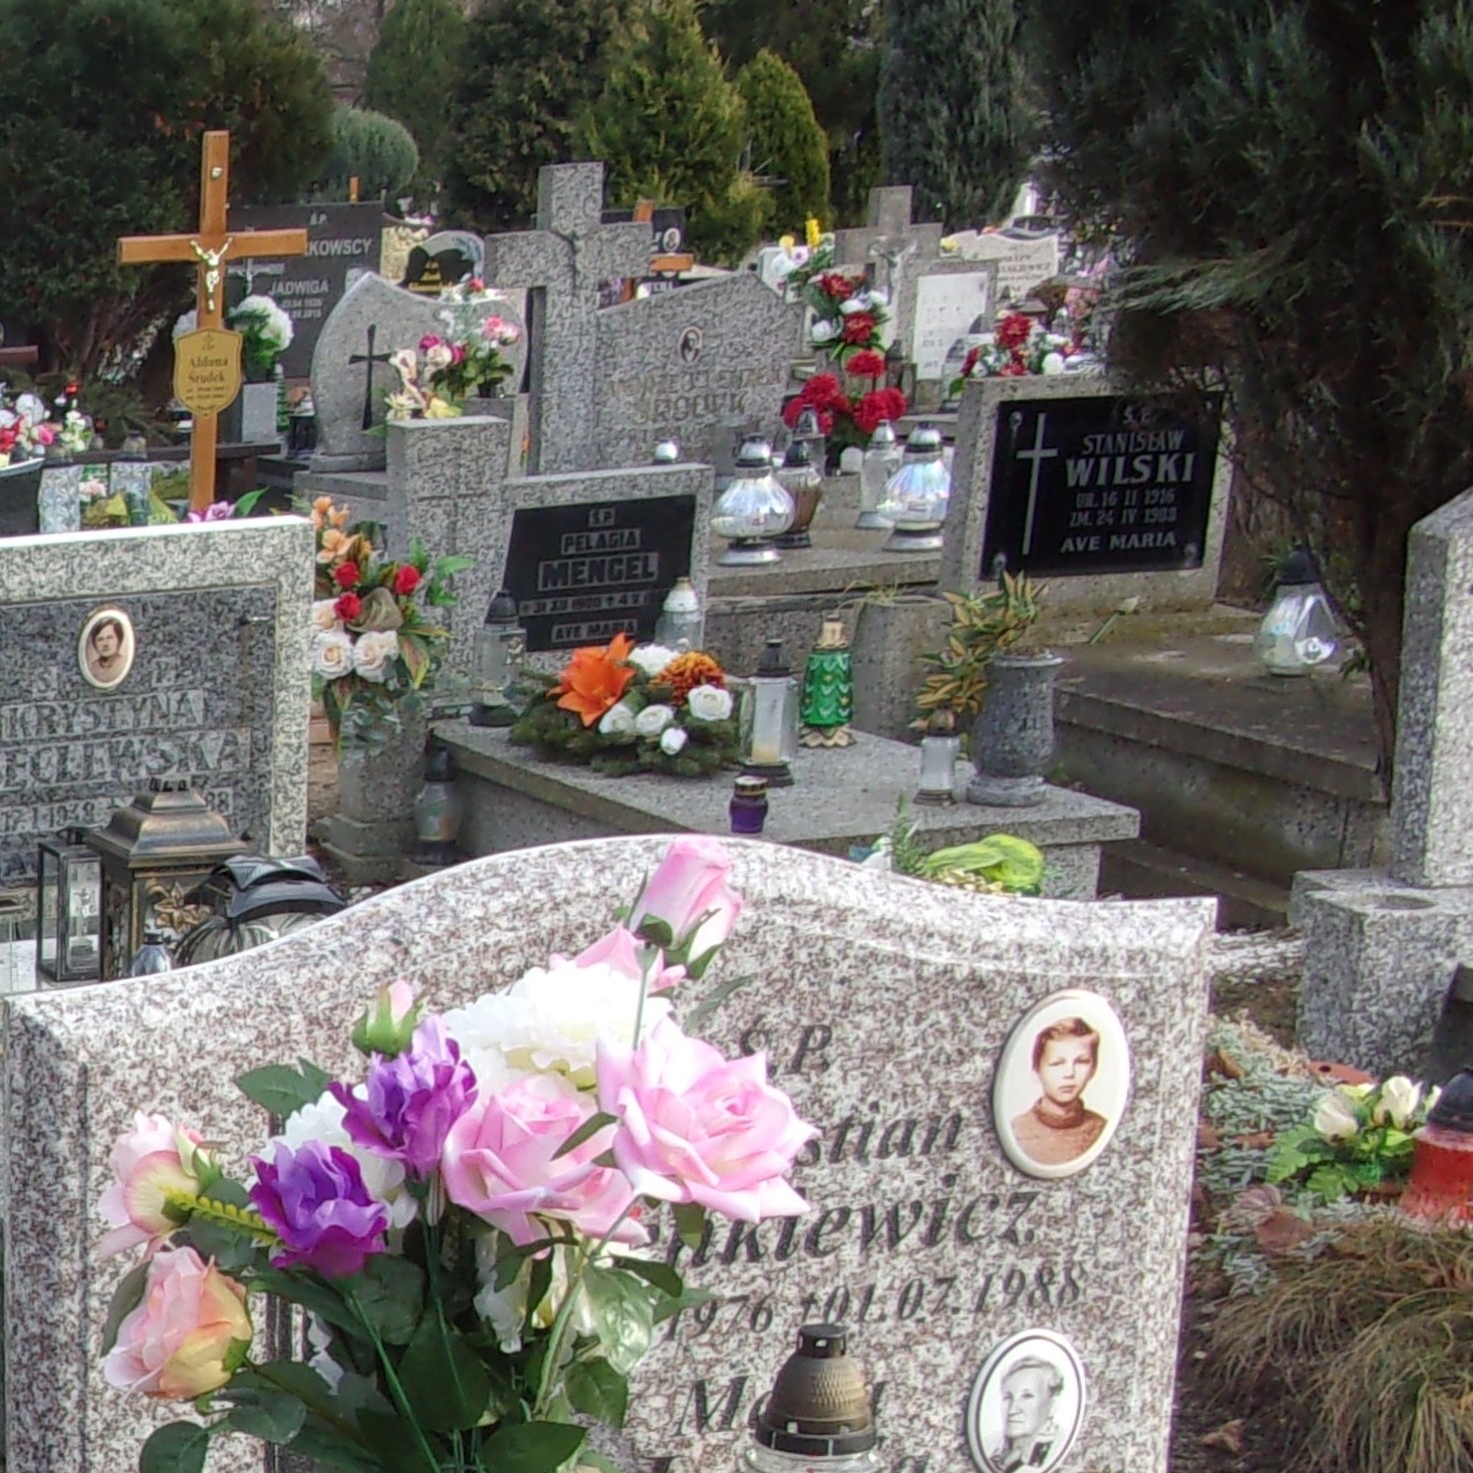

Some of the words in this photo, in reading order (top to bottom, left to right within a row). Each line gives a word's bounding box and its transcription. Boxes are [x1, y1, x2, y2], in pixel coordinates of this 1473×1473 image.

[308, 237, 372, 257] KOWSCY
[1065, 453, 1196, 488] WILSKI
[562, 528, 640, 554] PELAGIA
[1060, 536, 1102, 554] AVE
[1109, 531, 1178, 551] MARIA
[540, 554, 656, 589] MENGEL
[795, 1103, 963, 1166] stian
